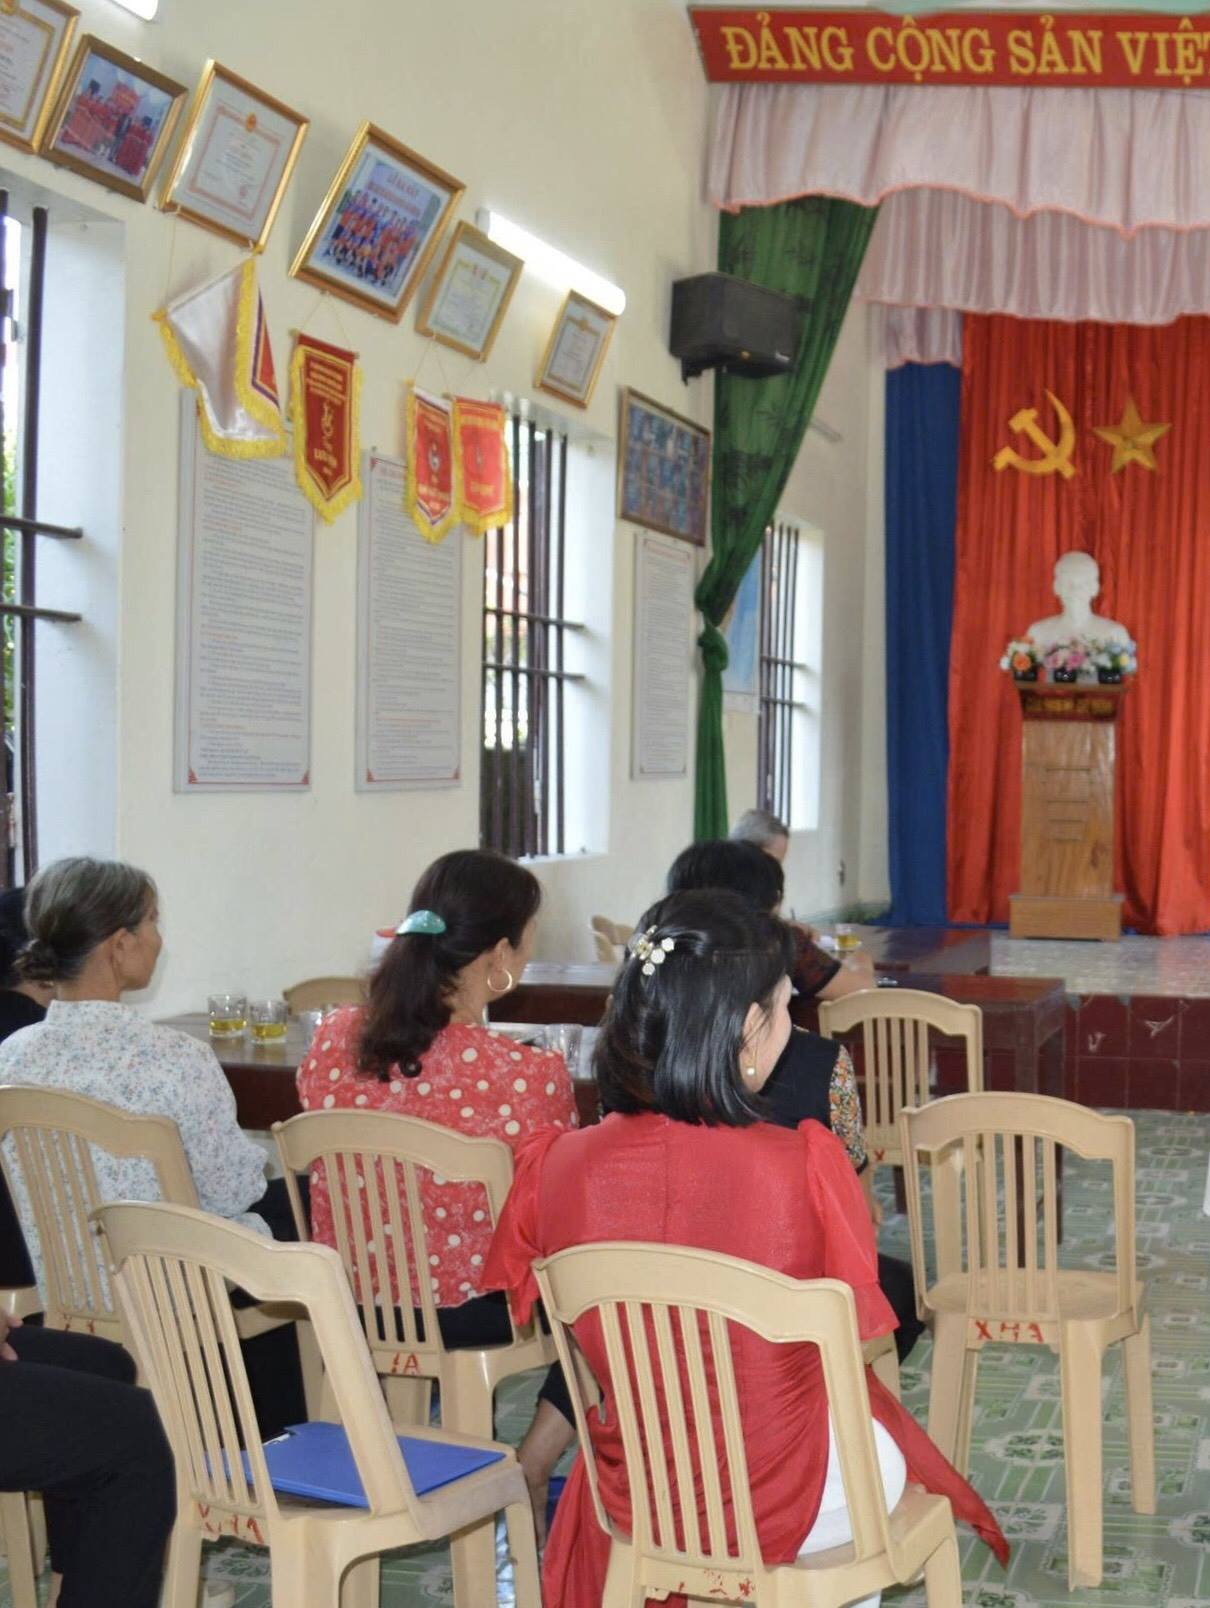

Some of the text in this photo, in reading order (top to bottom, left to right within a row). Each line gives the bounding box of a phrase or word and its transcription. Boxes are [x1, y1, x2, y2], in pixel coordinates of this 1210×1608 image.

[722, 12, 854, 71] ĐẢNG
[866, 15, 996, 82] CỘNG
[1009, 16, 1104, 74] SẢN
